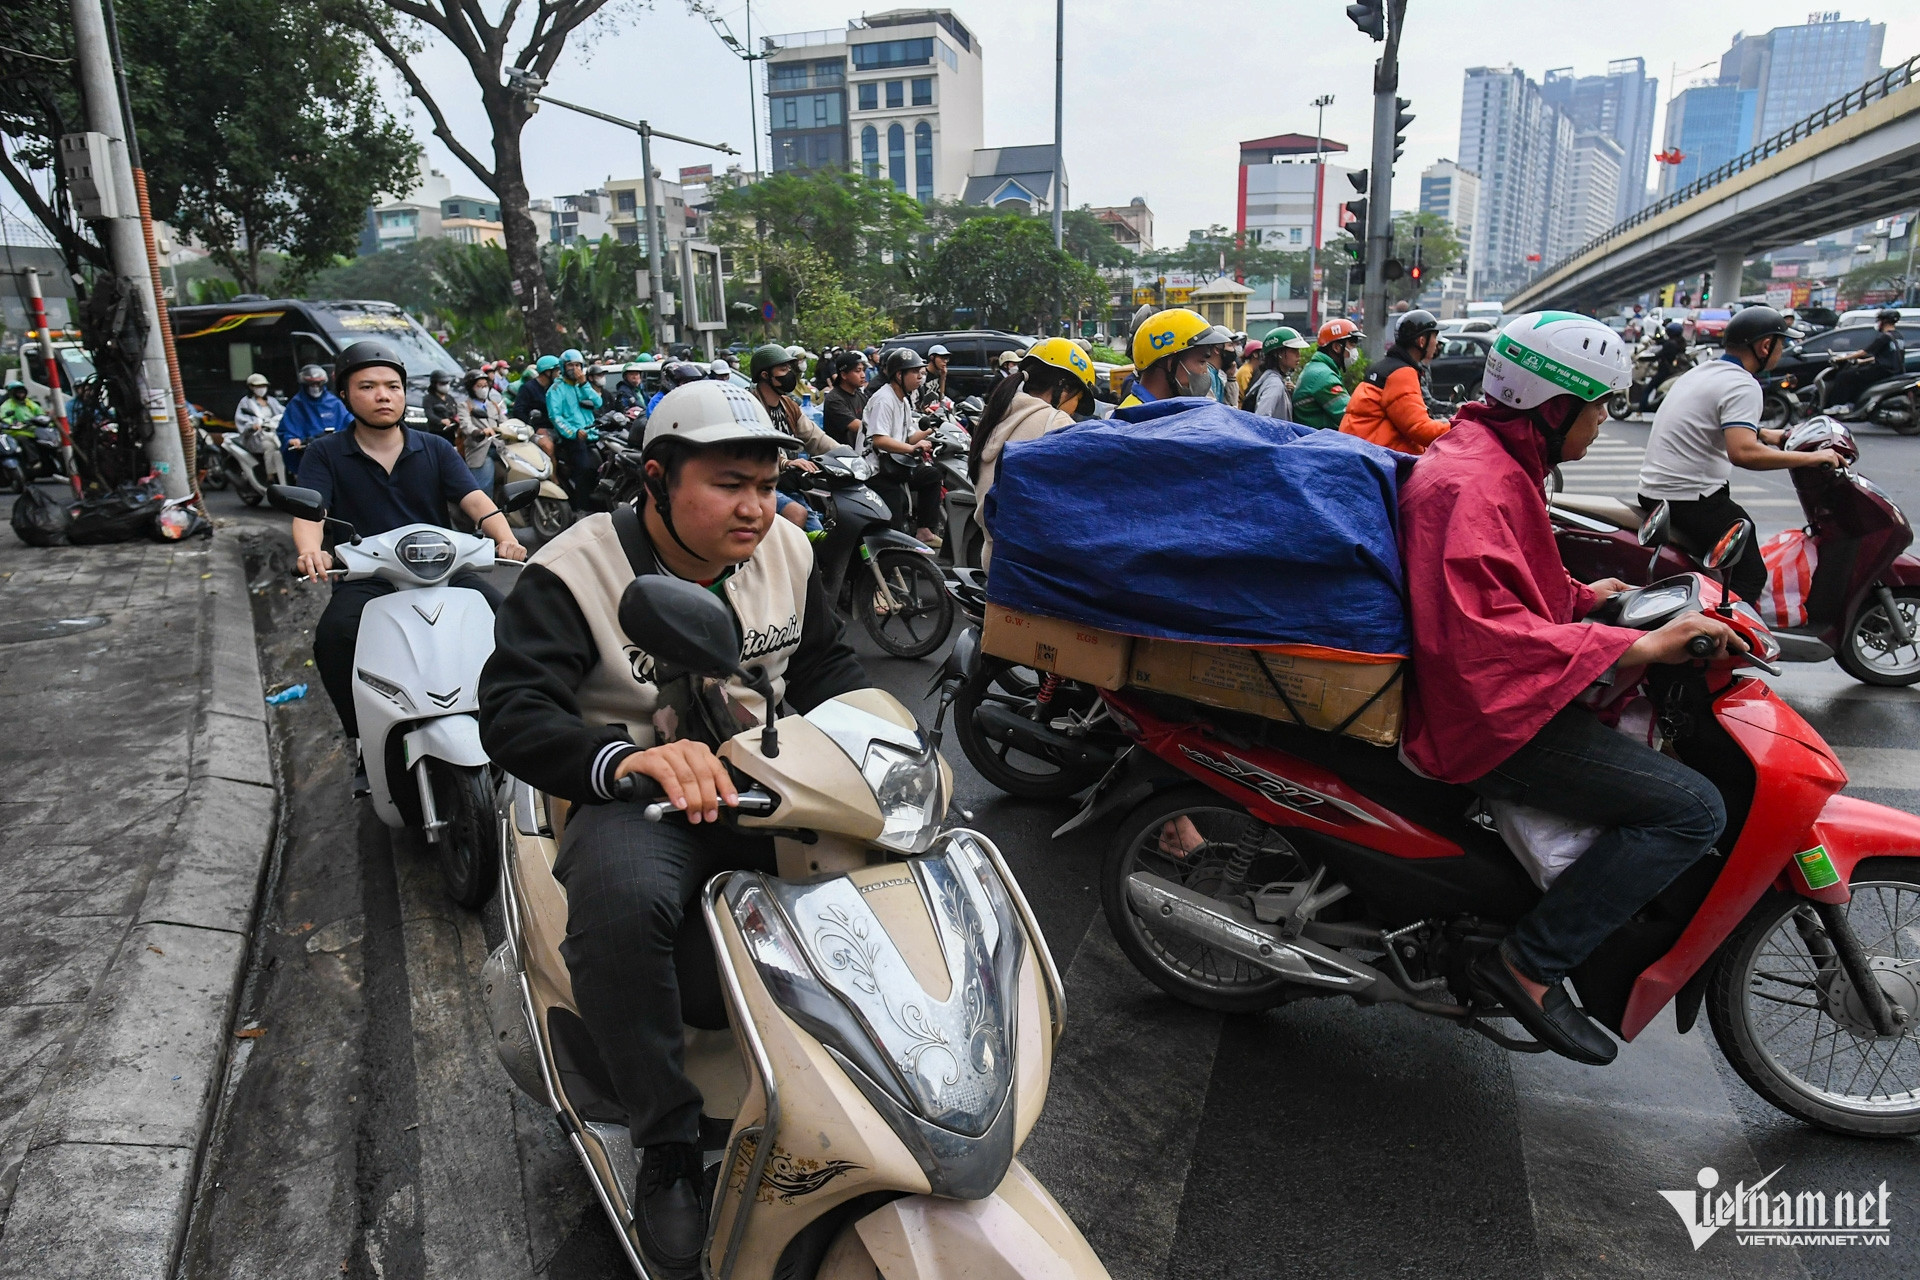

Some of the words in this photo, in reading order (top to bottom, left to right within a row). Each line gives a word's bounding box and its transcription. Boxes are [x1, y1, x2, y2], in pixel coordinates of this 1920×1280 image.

[1150, 331, 1175, 350] be
[901, 350, 913, 360] 69
[1069, 348, 1087, 371] be
[1076, 631, 1099, 645] KGS
[1136, 670, 1150, 682] BX
[860, 876, 916, 894] HONDA
